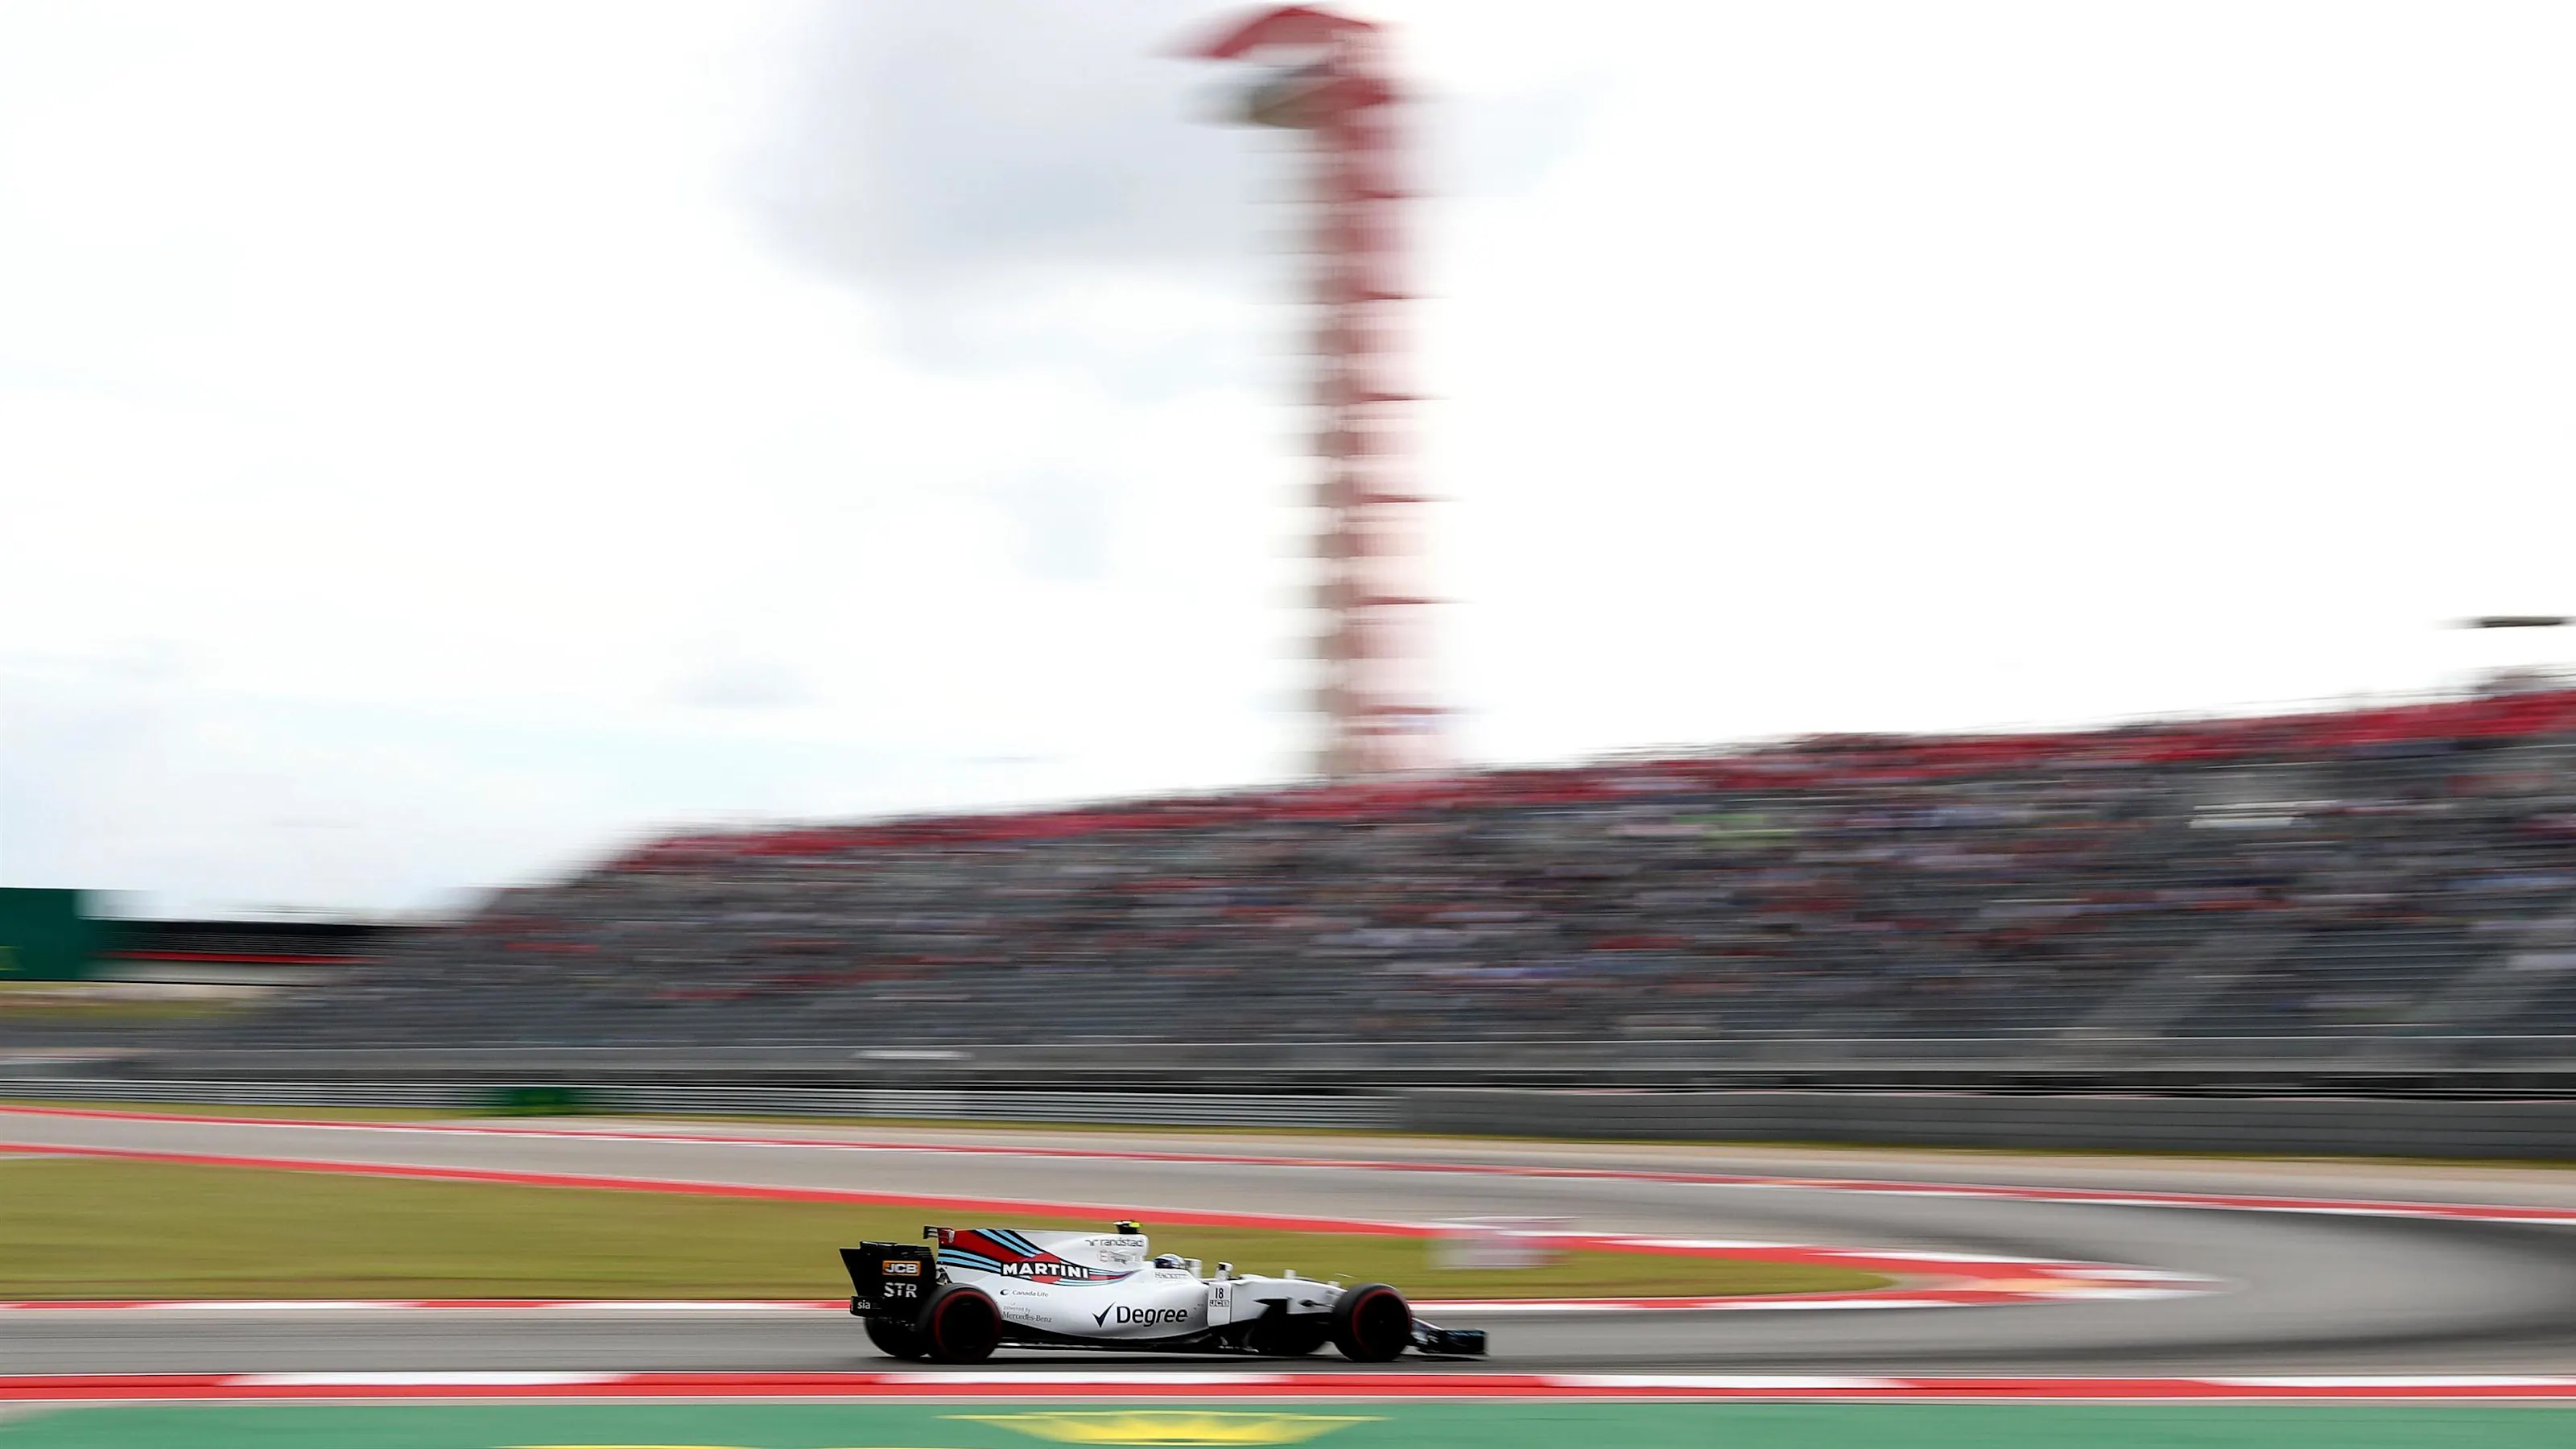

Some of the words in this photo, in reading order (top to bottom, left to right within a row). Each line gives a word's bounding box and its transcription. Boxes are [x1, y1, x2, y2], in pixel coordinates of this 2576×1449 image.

[1100, 1237, 1143, 1247] randstad
[885, 1263, 918, 1274] JCB
[1002, 1262, 1089, 1278] MARTINI
[883, 1282, 918, 1298] STR
[1215, 1287, 1224, 1299] 18
[857, 1299, 871, 1310] sia
[1001, 1311, 1053, 1323] Mercedes-Benz
[1117, 1306, 1188, 1327] Degree
